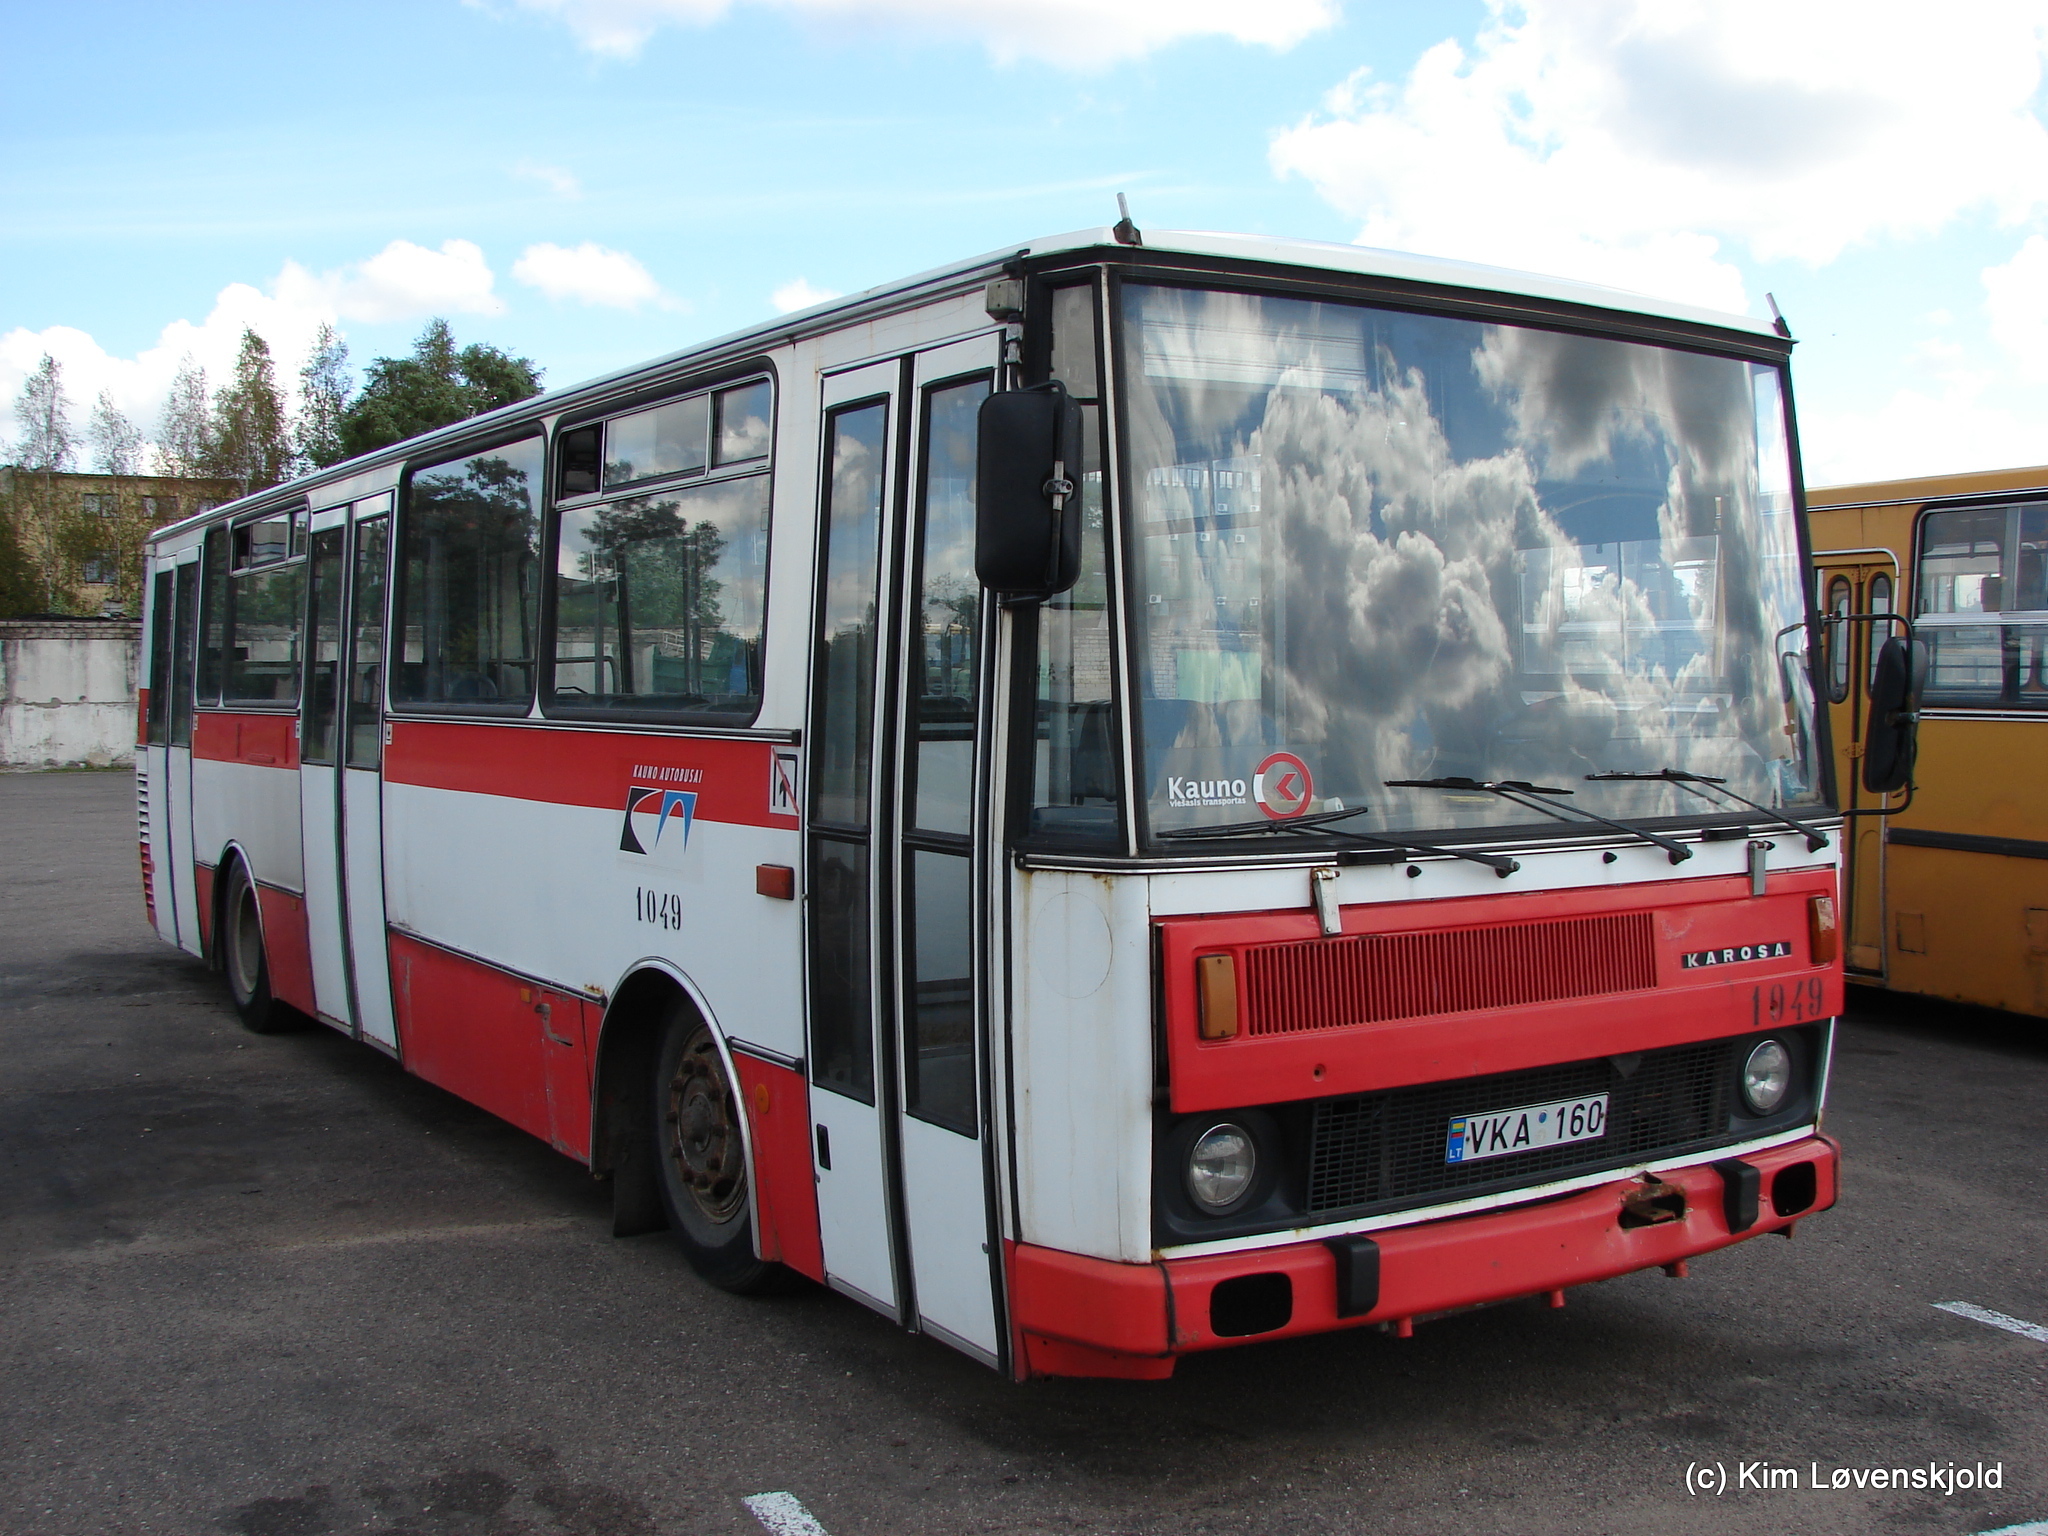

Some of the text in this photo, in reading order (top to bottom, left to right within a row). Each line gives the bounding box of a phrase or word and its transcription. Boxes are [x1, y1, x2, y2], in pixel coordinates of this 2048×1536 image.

[632, 764, 703, 784] KAUNO AUTOBUSAI
[1168, 776, 1246, 800] Kauno
[1202, 797, 1246, 807] transportas
[636, 886, 682, 931] 1049
[1687, 942, 1785, 968] KAROSA
[1752, 977, 1823, 1026] 1049
[1470, 1100, 1603, 1154] VKA 160
[1449, 1148, 1462, 1159] LT
